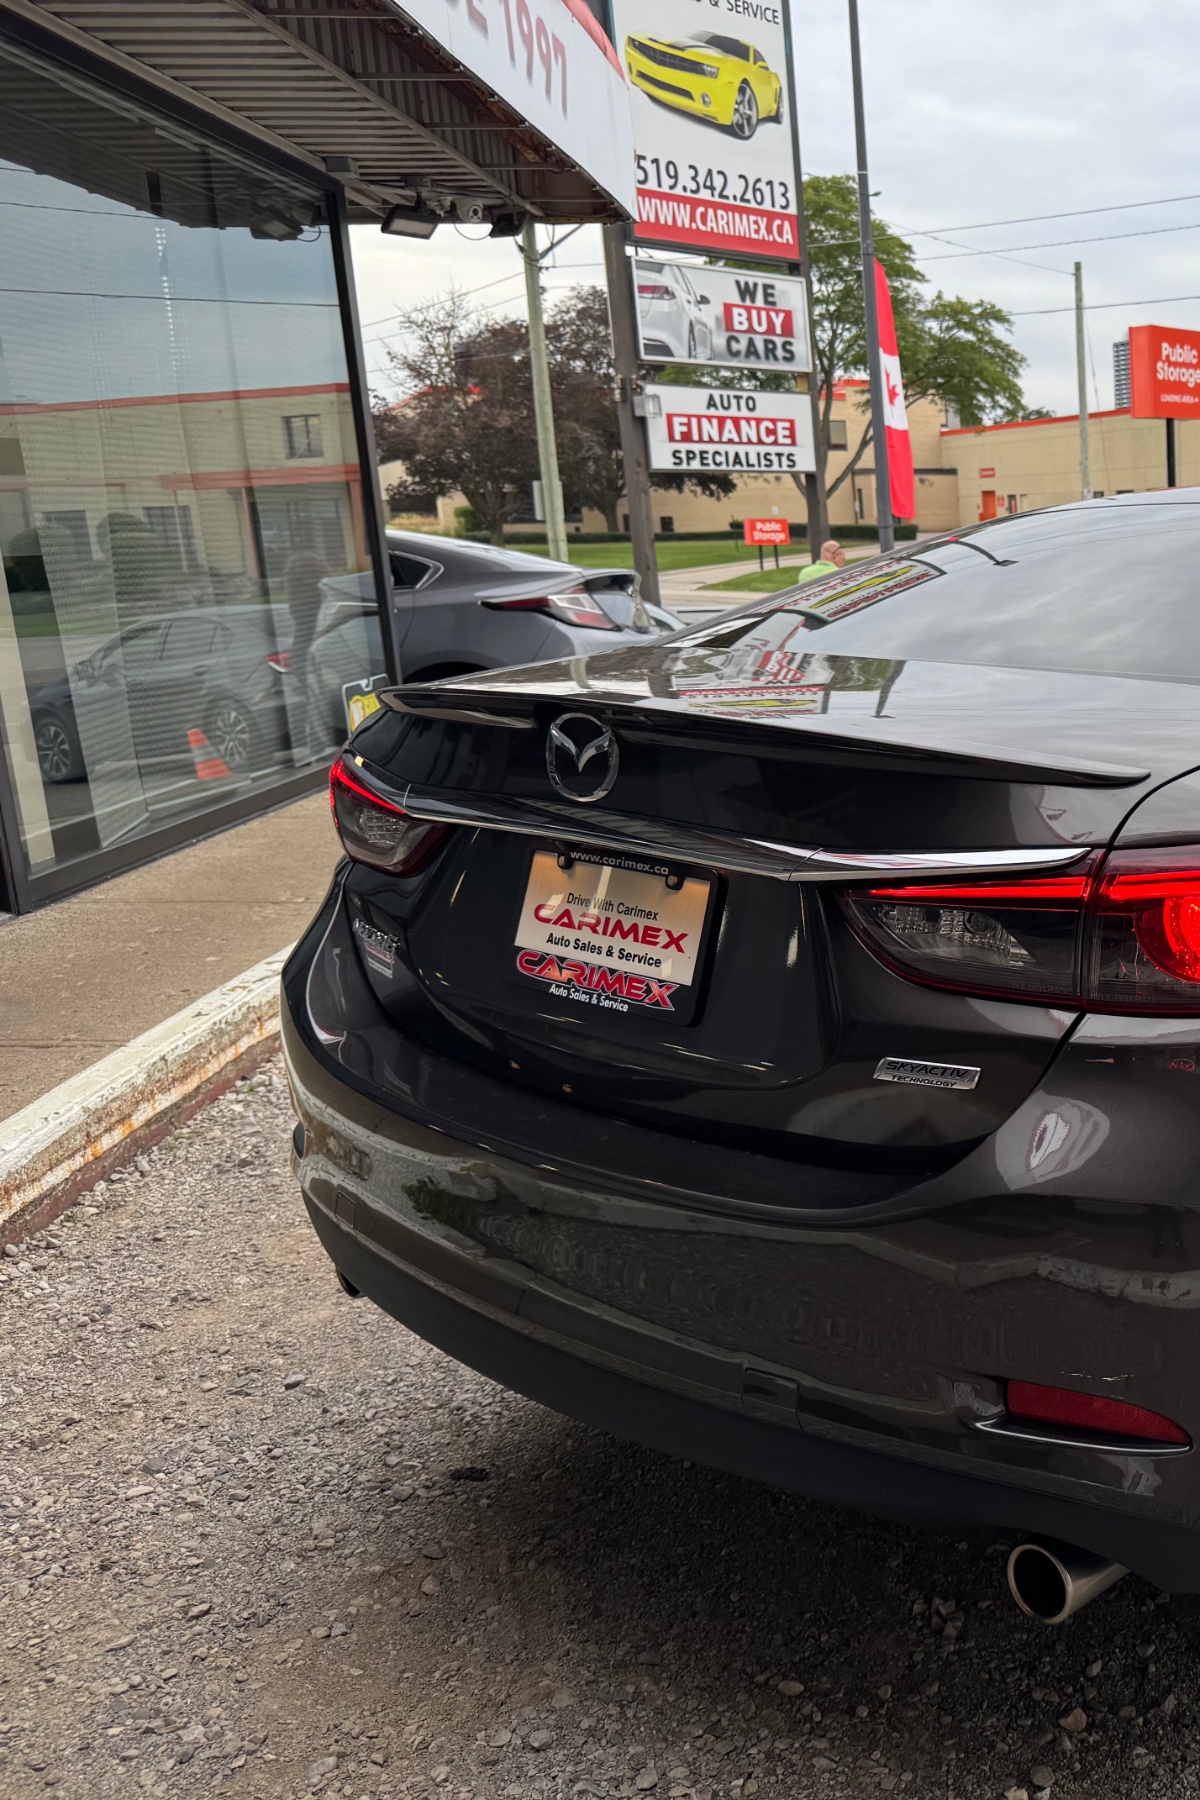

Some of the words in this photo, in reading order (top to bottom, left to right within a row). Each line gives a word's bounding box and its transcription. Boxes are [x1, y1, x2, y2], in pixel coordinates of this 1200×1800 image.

[727, 0, 780, 25] SERVICE
[499, 0, 567, 115] 1997
[637, 154, 790, 210] 519.342.2613
[638, 196, 794, 244] WWW.CARIMEX.CA
[735, 279, 777, 306] WE
[732, 307, 786, 335] BUY
[726, 335, 796, 363] CARS
[1161, 342, 1198, 364] Public
[706, 393, 757, 412] AUTO
[672, 416, 792, 445] FINANCE
[672, 450, 797, 468] SPECIALISTS
[752, 531, 786, 543] Storage
[755, 521, 782, 532] Public
[570, 851, 669, 875] www.carimex.ca
[567, 892, 590, 908] Drive
[592, 895, 614, 913] With
[616, 902, 659, 921] Carimex
[533, 903, 690, 953] CARIMEX
[546, 932, 571, 948] Auto
[573, 938, 604, 955] Sales
[606, 945, 614, 957] &
[617, 948, 662, 968] Service
[517, 949, 679, 1010] CARIMEX
[549, 984, 568, 997] Auto
[570, 988, 590, 1003] Sales
[592, 994, 598, 1004] &
[599, 996, 629, 1012] Service
[885, 1061, 969, 1078] SKYACTIV
[891, 1075, 957, 1087] TECHNOLOGY
